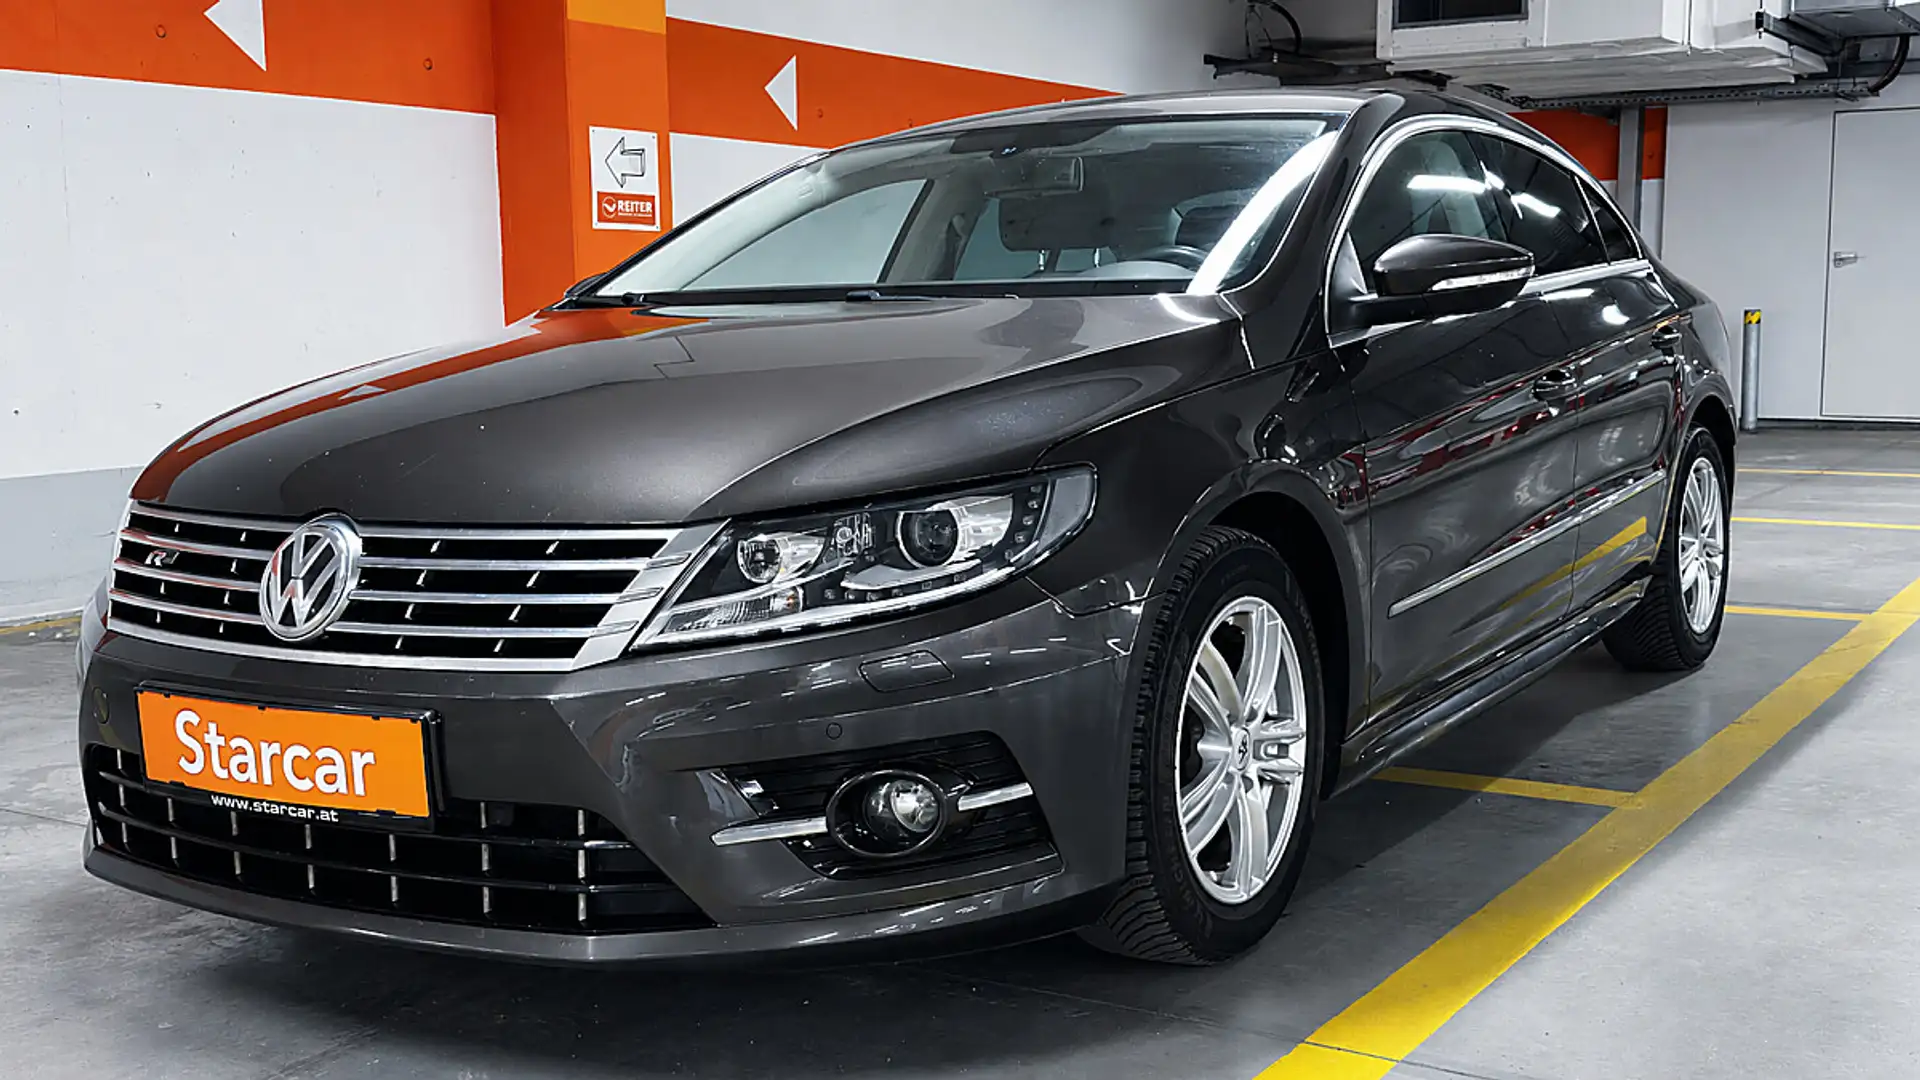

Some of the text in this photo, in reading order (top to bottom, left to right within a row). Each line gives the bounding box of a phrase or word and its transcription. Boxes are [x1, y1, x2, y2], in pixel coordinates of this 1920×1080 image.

[618, 200, 652, 213] REITER
[174, 708, 376, 796] Starcar
[211, 794, 339, 822] www.starcar.at
